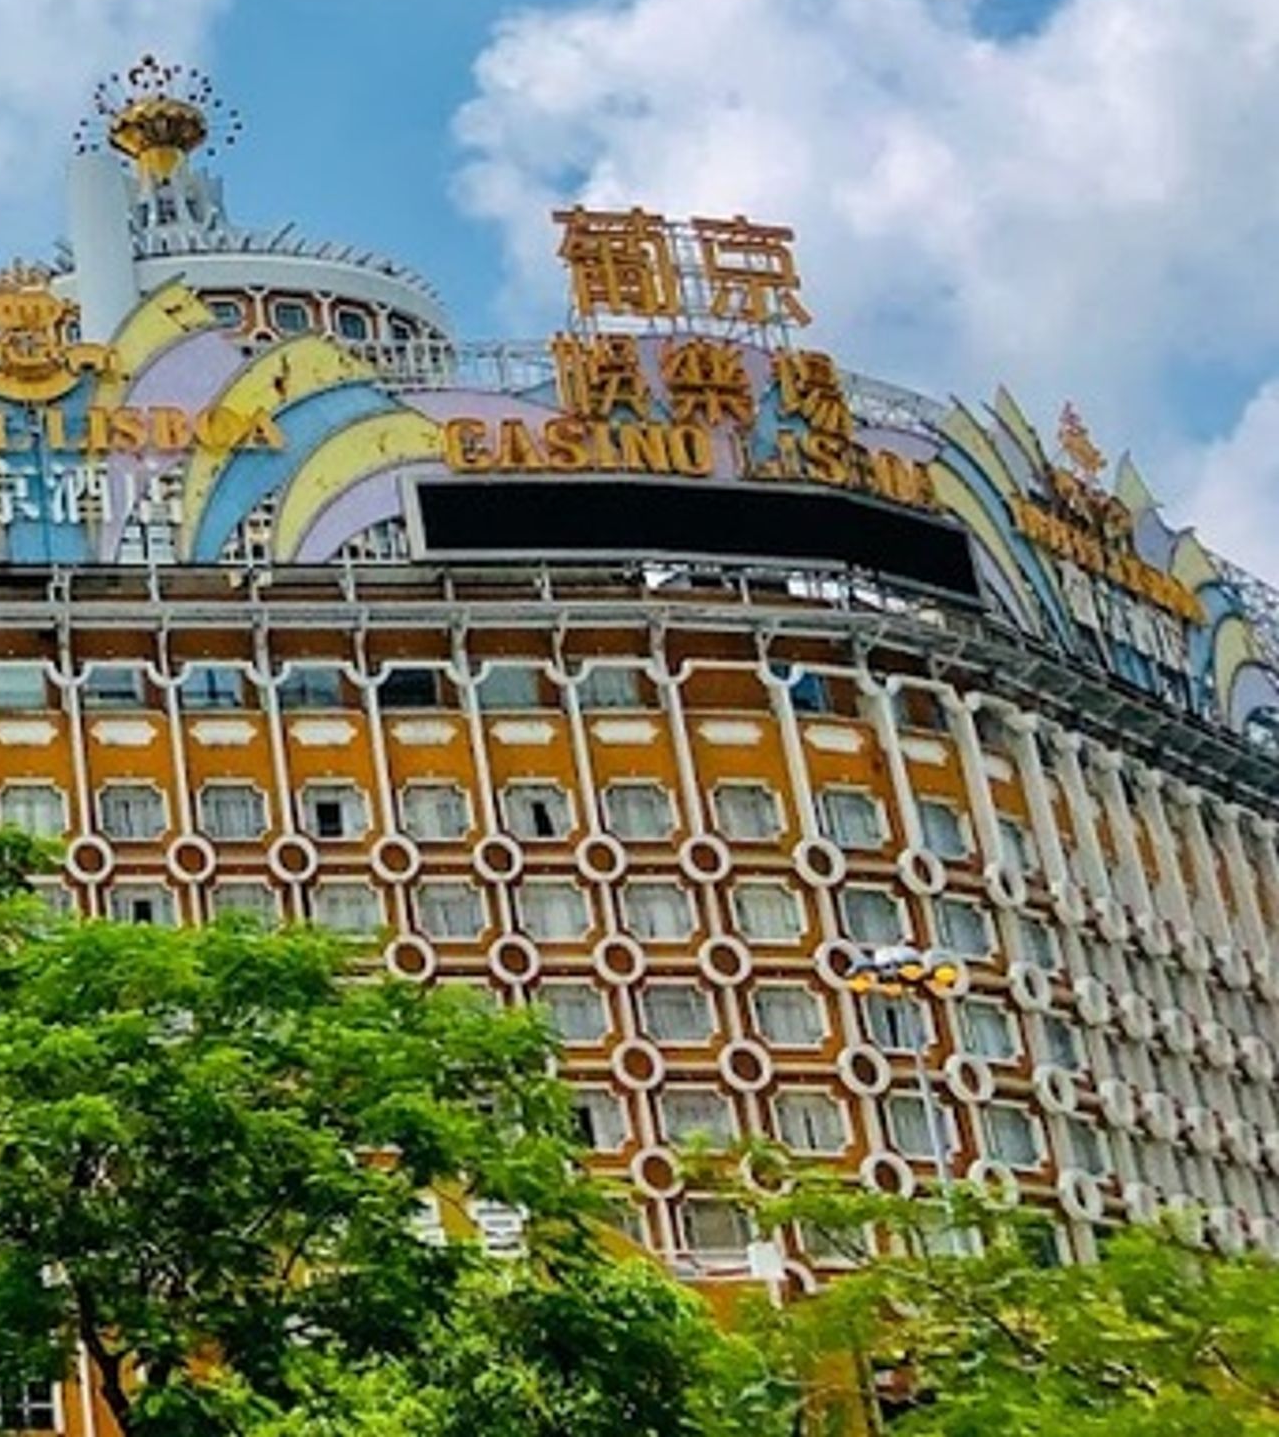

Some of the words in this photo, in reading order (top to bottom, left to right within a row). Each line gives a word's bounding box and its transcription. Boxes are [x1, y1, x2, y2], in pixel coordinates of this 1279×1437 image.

[551, 206, 813, 327] 葡京
[44, 405, 285, 455] LISBOA
[445, 416, 713, 477] CASINO
